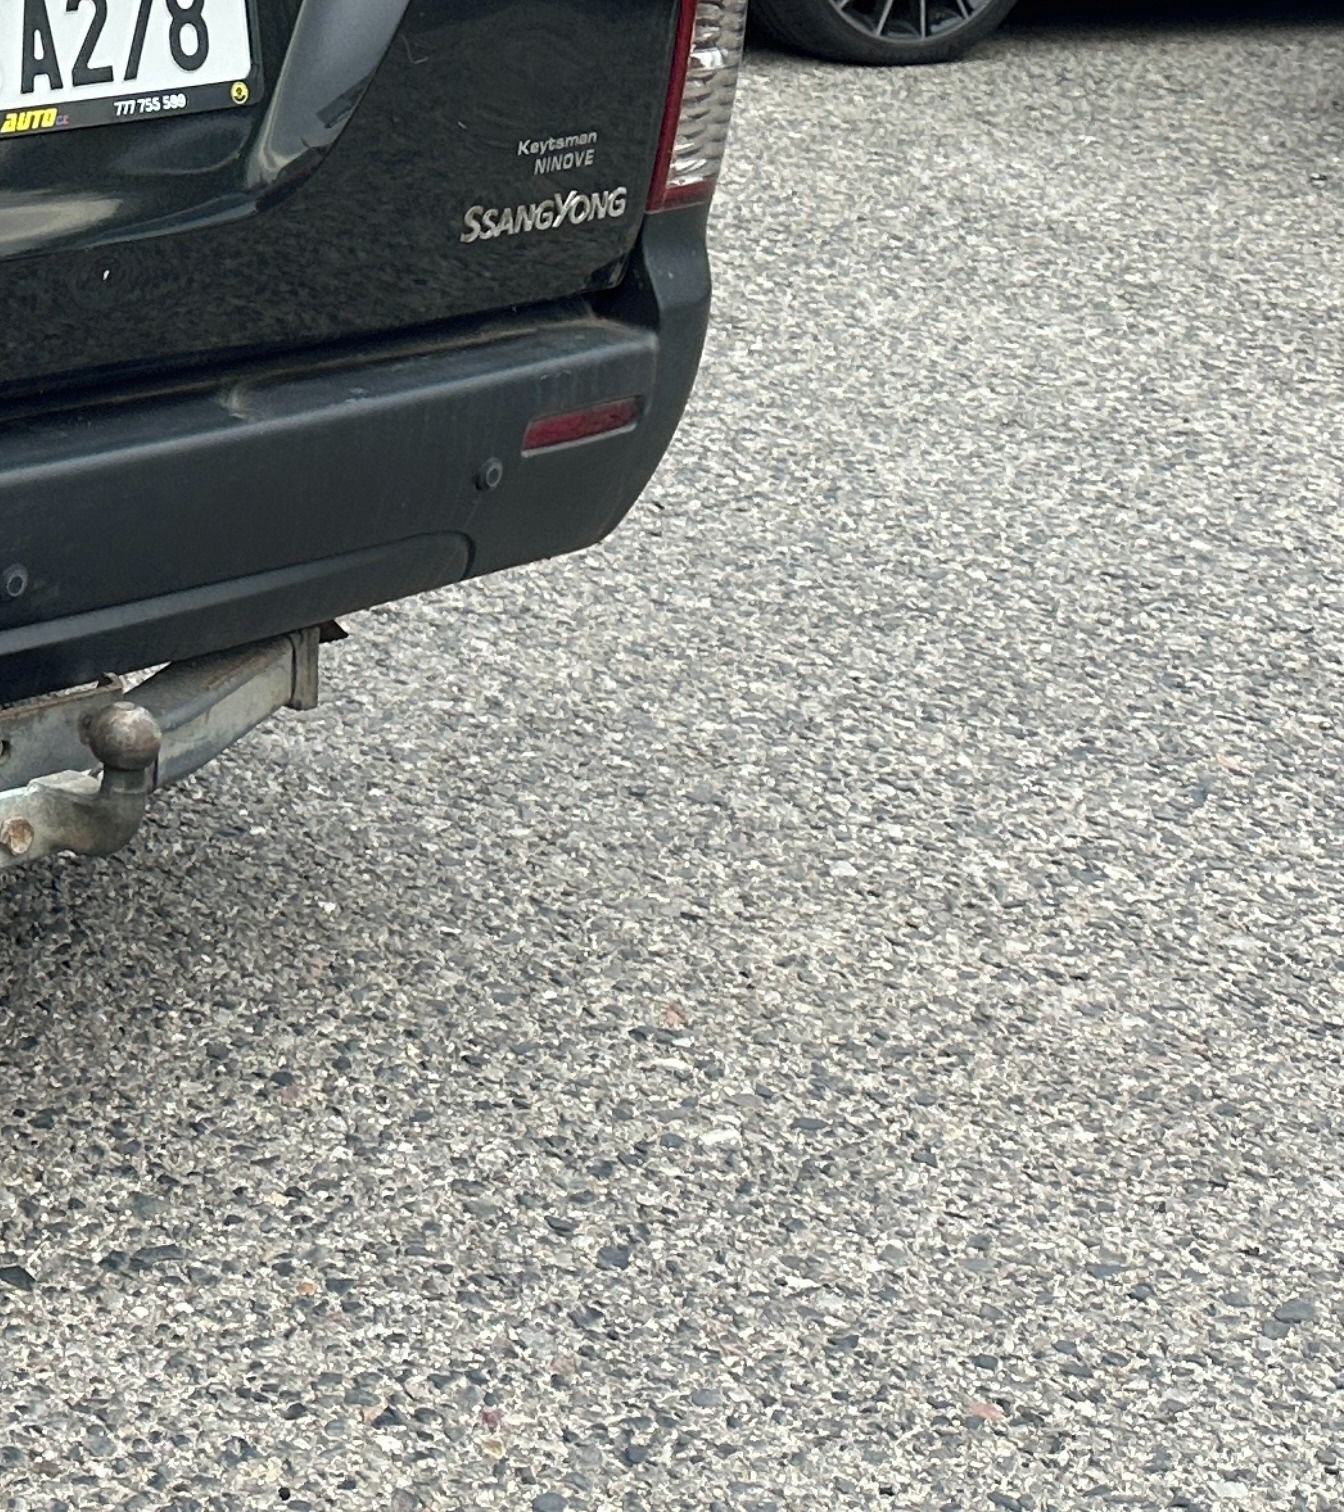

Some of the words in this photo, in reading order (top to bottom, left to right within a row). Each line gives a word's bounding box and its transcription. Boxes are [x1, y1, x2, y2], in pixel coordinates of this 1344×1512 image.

[113, 99, 136, 117] 777
[137, 96, 161, 114] 755
[0, 107, 58, 133] AUTO
[517, 131, 598, 157] Keytsman
[533, 148, 595, 176] NINOVE
[459, 186, 628, 244] SSANGYONG
